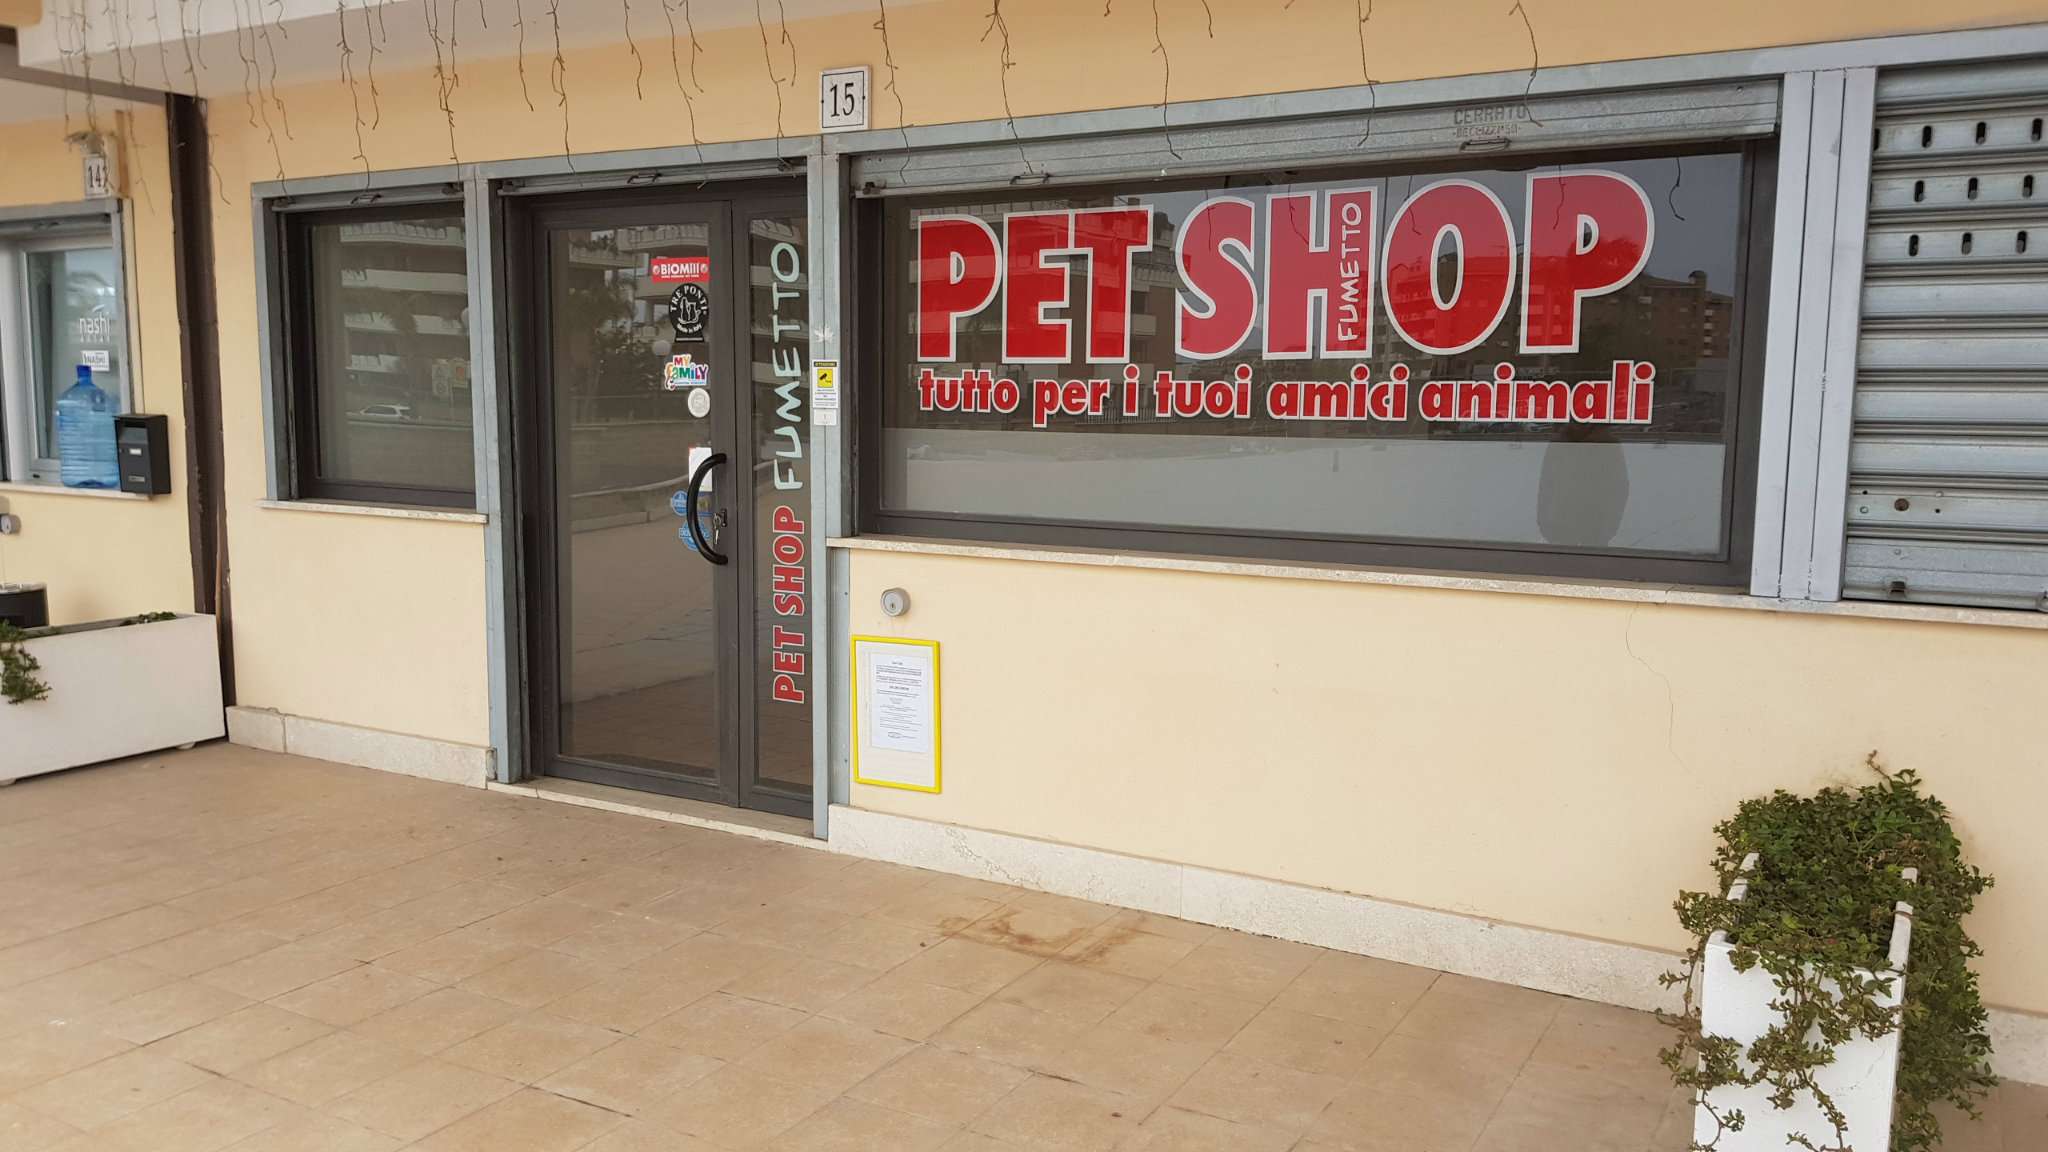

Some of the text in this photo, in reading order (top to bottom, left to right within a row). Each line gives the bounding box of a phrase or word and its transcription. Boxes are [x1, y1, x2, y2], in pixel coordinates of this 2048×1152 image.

[829, 82, 855, 117] 15
[1453, 104, 1527, 125] CERRATO
[917, 168, 1655, 364] PET SHOP
[1337, 202, 1362, 342] FUMETTO
[79, 311, 110, 334] nashi
[670, 285, 708, 313] TRE PONTI
[673, 354, 691, 367] MY
[770, 242, 803, 490] FUMETTO
[917, 360, 1656, 428] tutto per i tuoi amici animali
[772, 505, 805, 704] PET SHOP
